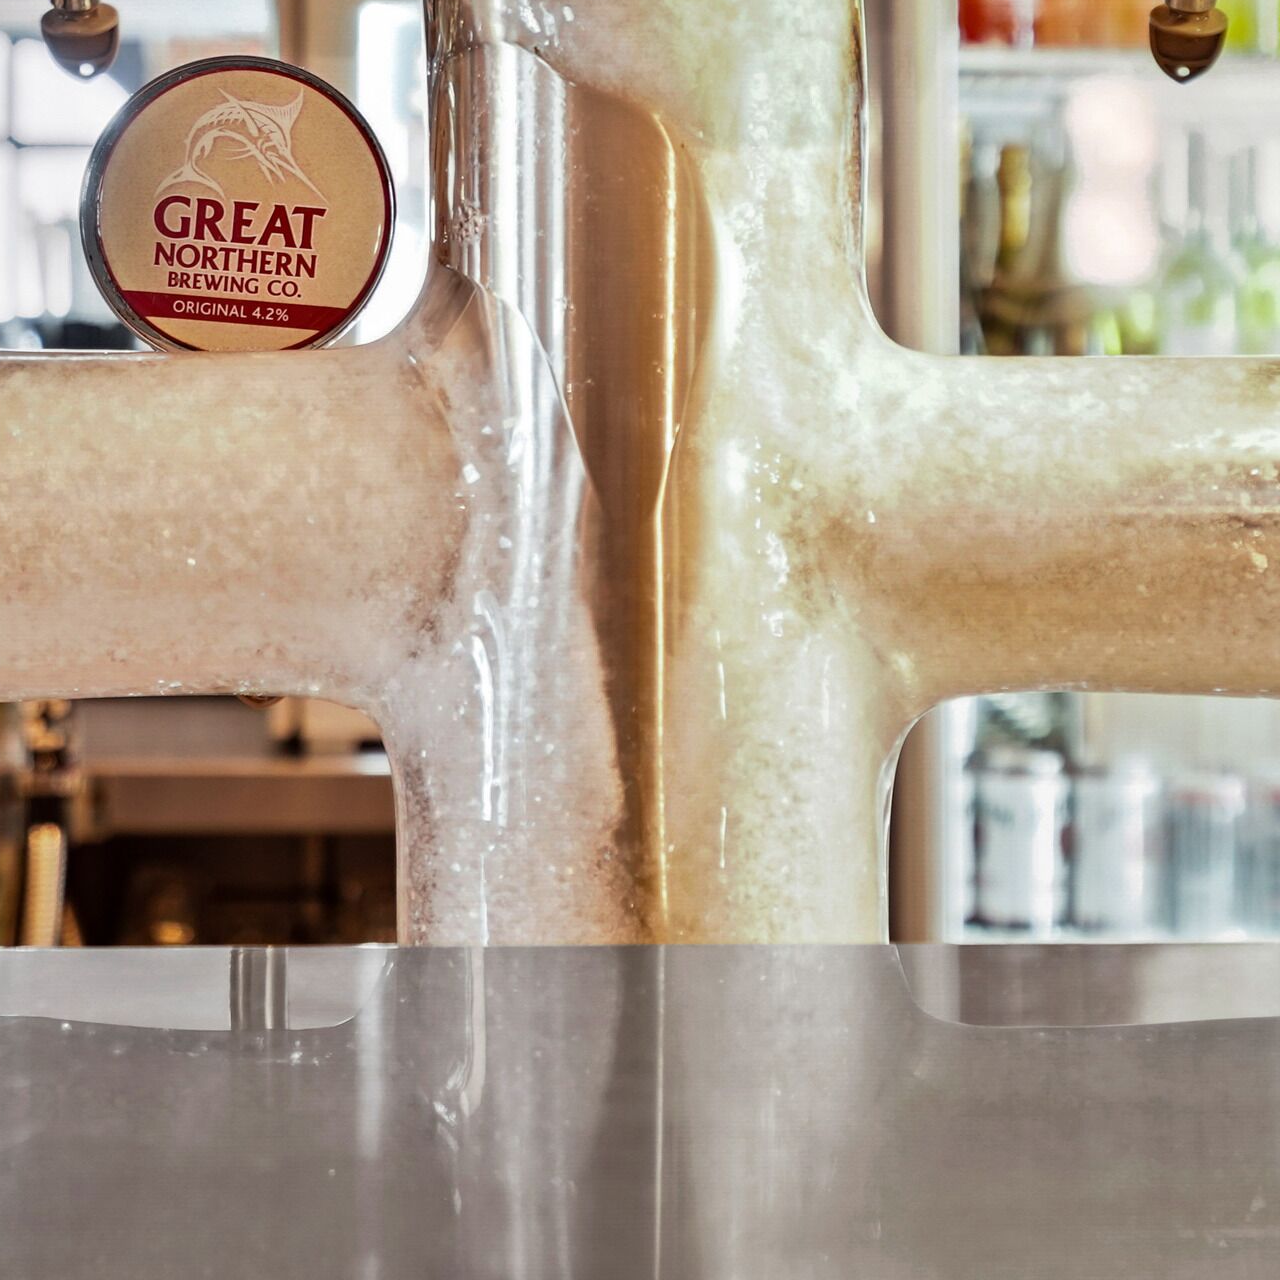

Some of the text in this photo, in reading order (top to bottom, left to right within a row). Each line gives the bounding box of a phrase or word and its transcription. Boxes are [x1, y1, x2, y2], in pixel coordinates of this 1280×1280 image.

[153, 194, 328, 251] GREAT
[153, 241, 318, 279] NORTHERN
[167, 271, 302, 299] BREWING CO.
[172, 299, 290, 322] ORIGINAL 4.2%
